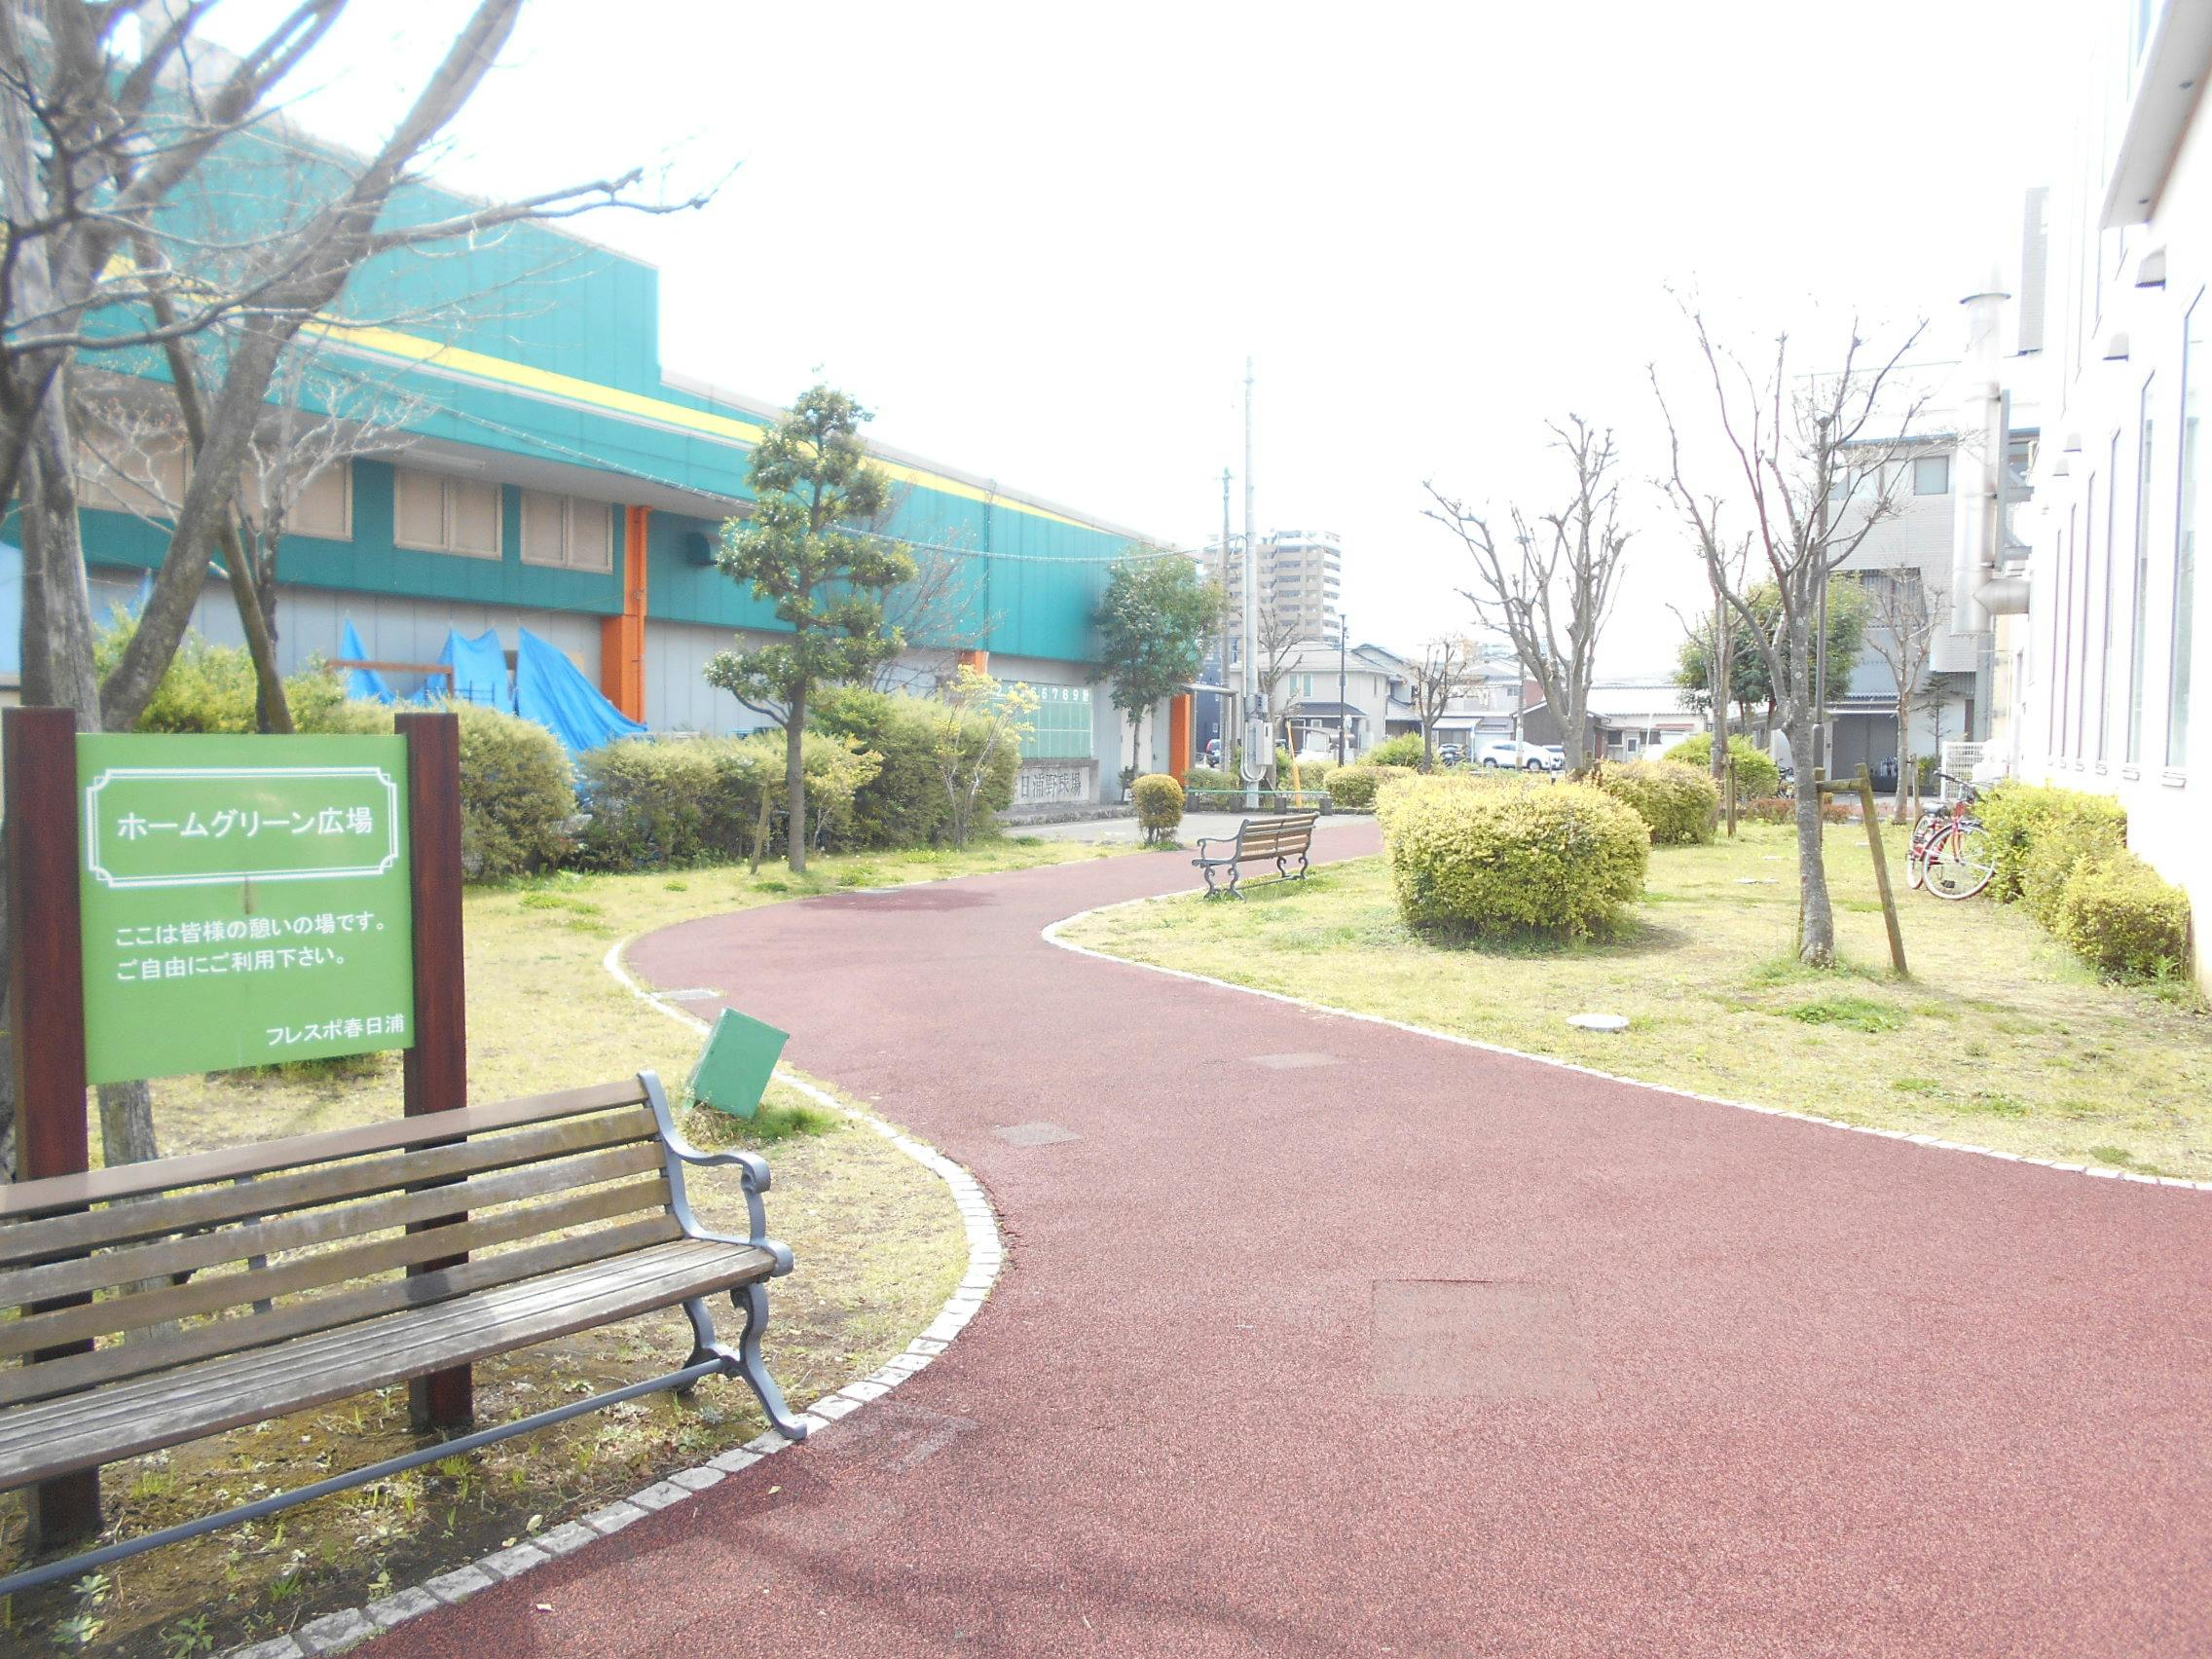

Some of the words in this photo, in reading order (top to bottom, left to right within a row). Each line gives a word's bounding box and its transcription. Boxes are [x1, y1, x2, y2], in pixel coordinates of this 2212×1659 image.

[1041, 686, 1048, 700] 6
[1051, 687, 1058, 700] 7
[1062, 688, 1069, 701] 8
[1073, 688, 1079, 701] 9
[1015, 772, 1082, 797] 日浦野球場
[117, 806, 374, 841] ホームグリーン広場
[116, 911, 386, 945] ここは皆様の憩いの場です。
[117, 945, 346, 980] ご自由にご利用下さい。
[266, 1014, 405, 1046] フレスポ春日浦
